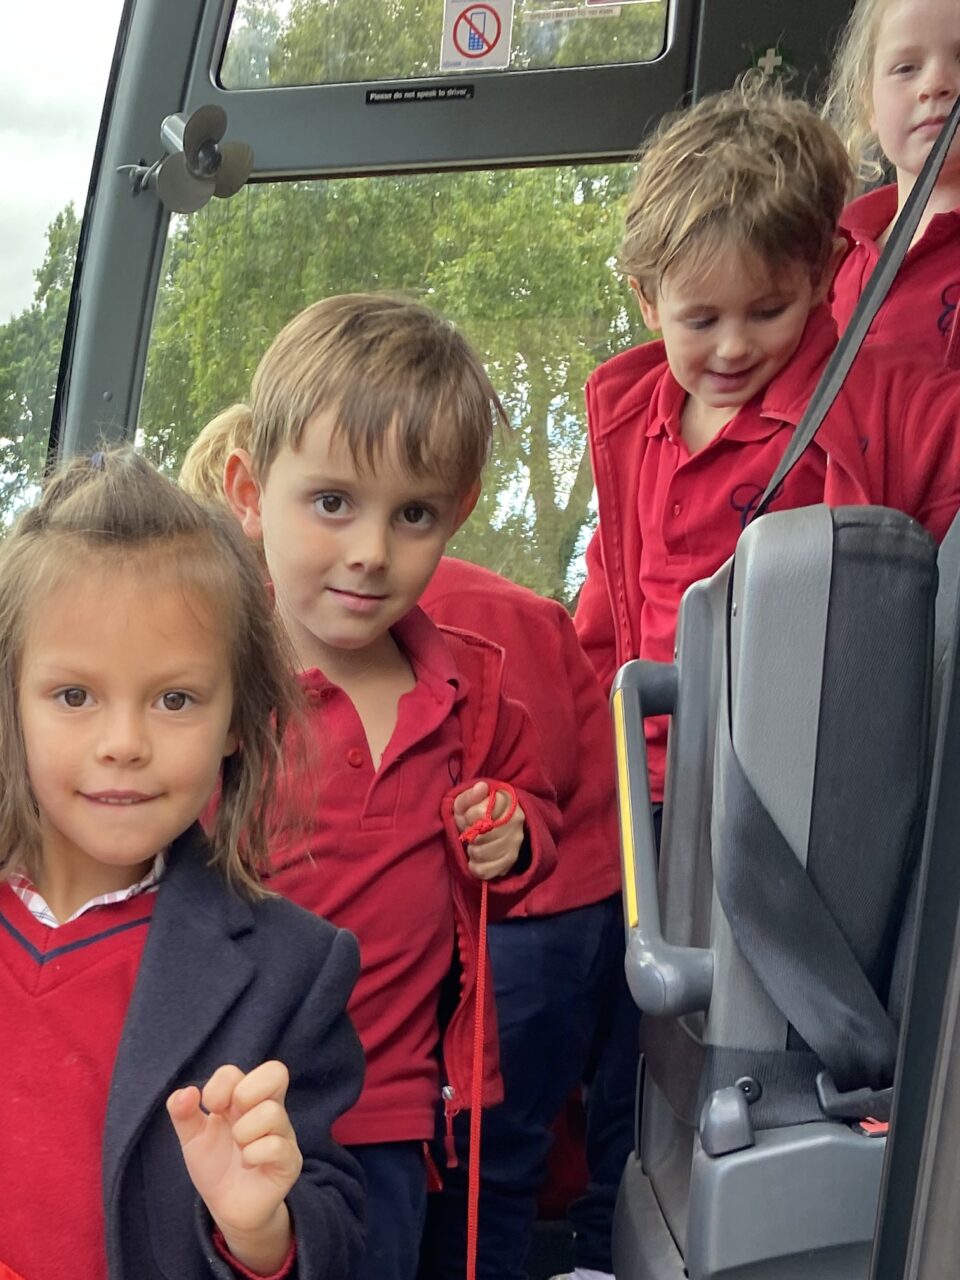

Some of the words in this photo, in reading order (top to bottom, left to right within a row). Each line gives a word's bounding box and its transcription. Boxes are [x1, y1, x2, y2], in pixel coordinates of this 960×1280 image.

[370, 92, 392, 100] Please
[393, 91, 403, 100] do
[404, 91, 415, 99] not
[417, 90, 436, 99] speak
[438, 88, 446, 97] to
